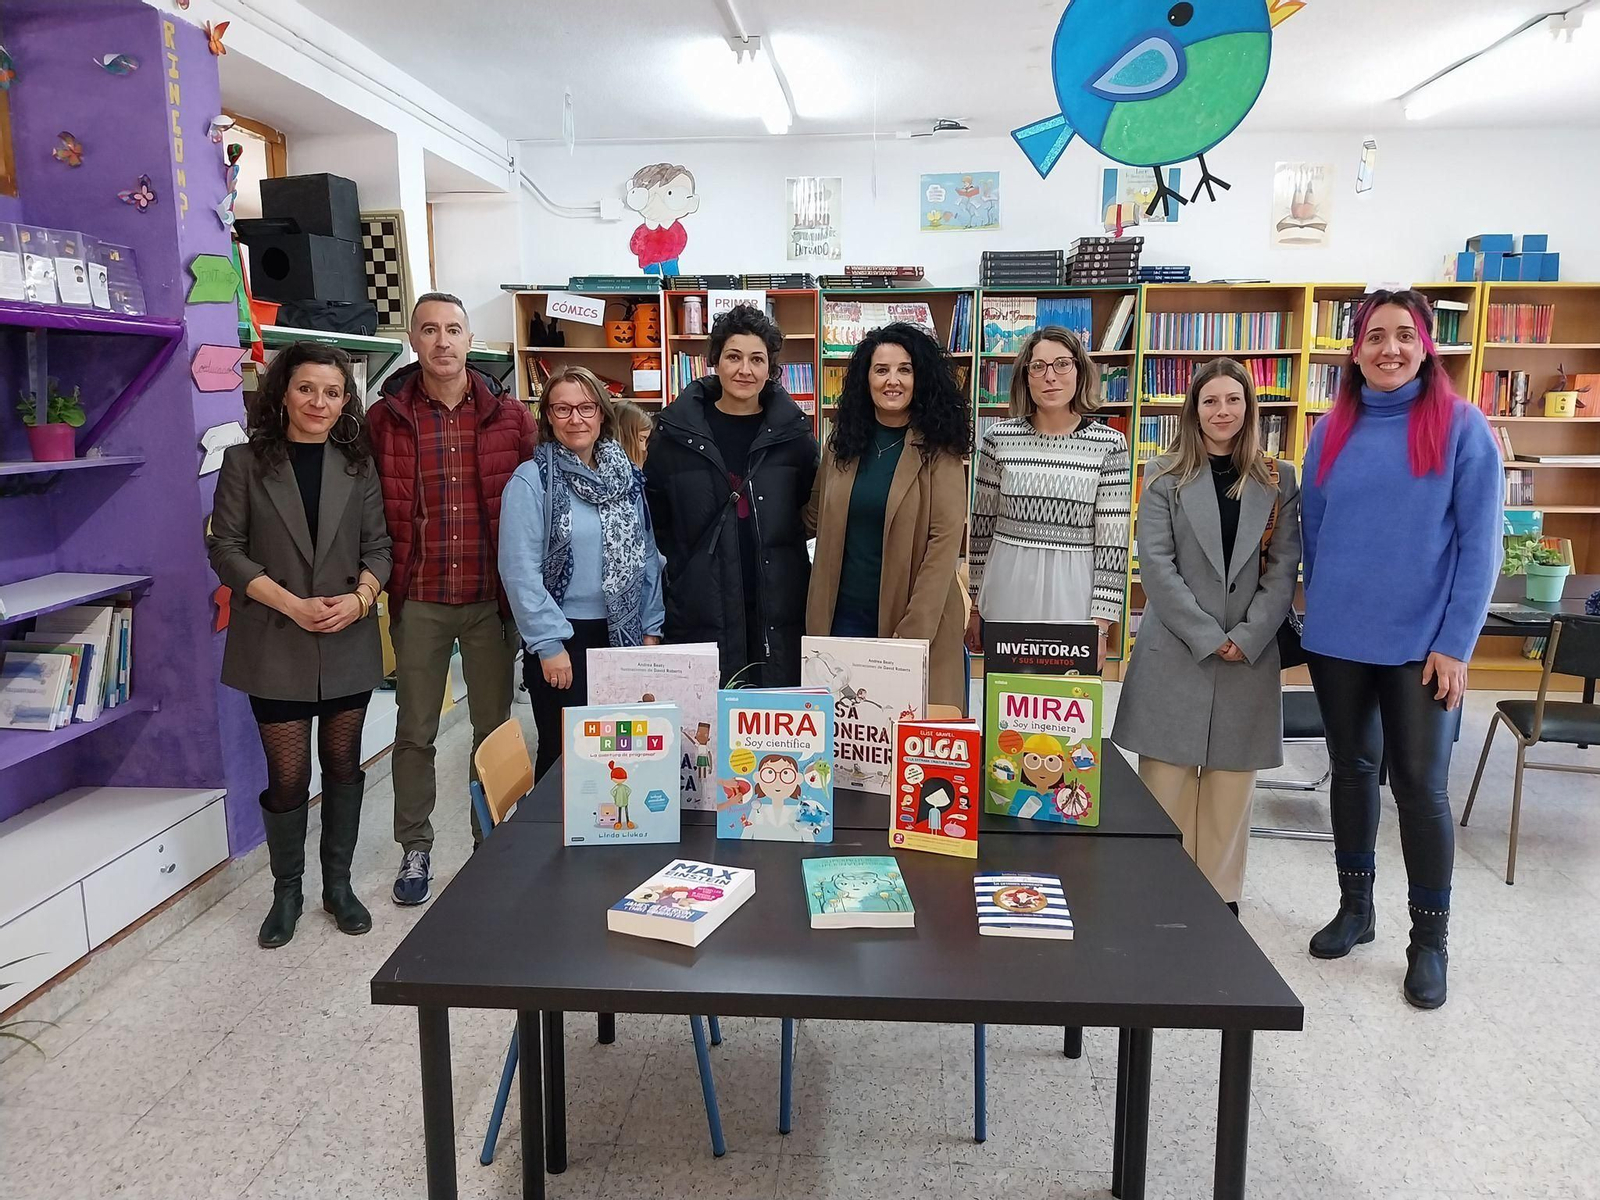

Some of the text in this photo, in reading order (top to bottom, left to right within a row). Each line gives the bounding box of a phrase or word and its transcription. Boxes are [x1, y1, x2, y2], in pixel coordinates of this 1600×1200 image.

[551, 301, 598, 318] CÓMICS
[996, 642, 1090, 657] INVENTORAS
[1036, 658, 1075, 666] INVENTOS
[1007, 694, 1085, 723] MIRA
[588, 723, 644, 734] HOLA
[738, 711, 817, 737] MIRA
[1013, 720, 1076, 733] Soy ingeniera
[834, 721, 890, 745] ONERA
[604, 738, 659, 749] RUBY
[744, 736, 811, 749] Soy científica
[904, 736, 969, 761] OLGA
[834, 741, 892, 765] GENIER
[664, 870, 731, 886] EINSTEIN
[671, 863, 739, 880] MAX
